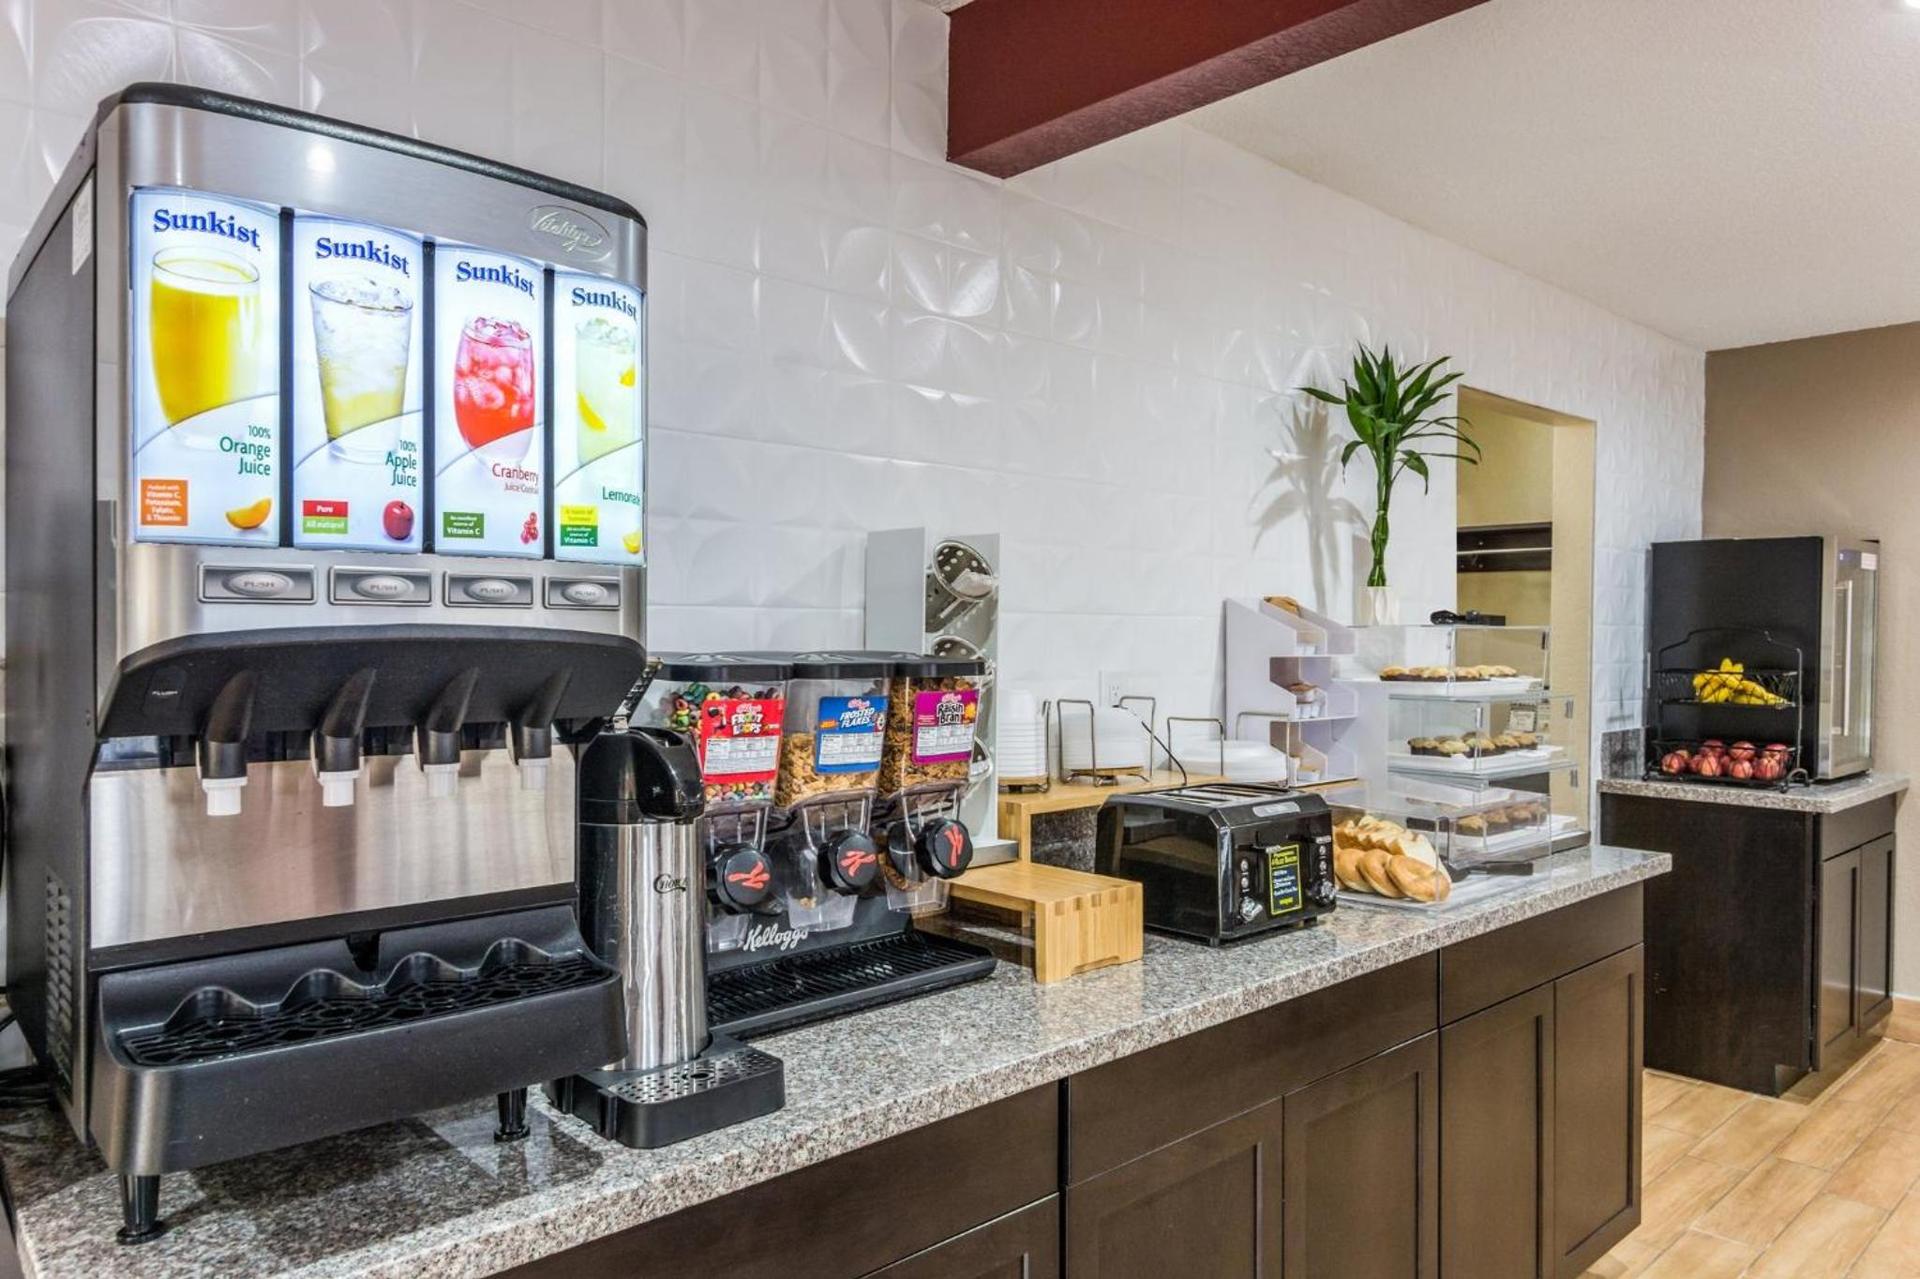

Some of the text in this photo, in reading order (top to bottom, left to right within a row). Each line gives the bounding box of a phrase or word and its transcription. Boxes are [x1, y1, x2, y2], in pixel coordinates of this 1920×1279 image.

[153, 208, 261, 248] Sunkist
[315, 237, 410, 275] Sunkist
[456, 261, 535, 298] Sunkist
[571, 287, 638, 320] Sunkist
[248, 425, 271, 439] 100%
[219, 436, 271, 461] Orange
[399, 440, 417, 452] 100%
[238, 457, 271, 476] Juice
[385, 451, 417, 473] Apple
[391, 468, 417, 487] Juice
[475, 527, 481, 535] C
[840, 707, 875, 721] FROSTED
[937, 703, 964, 716] Raisin
[841, 717, 870, 728] FLAKES
